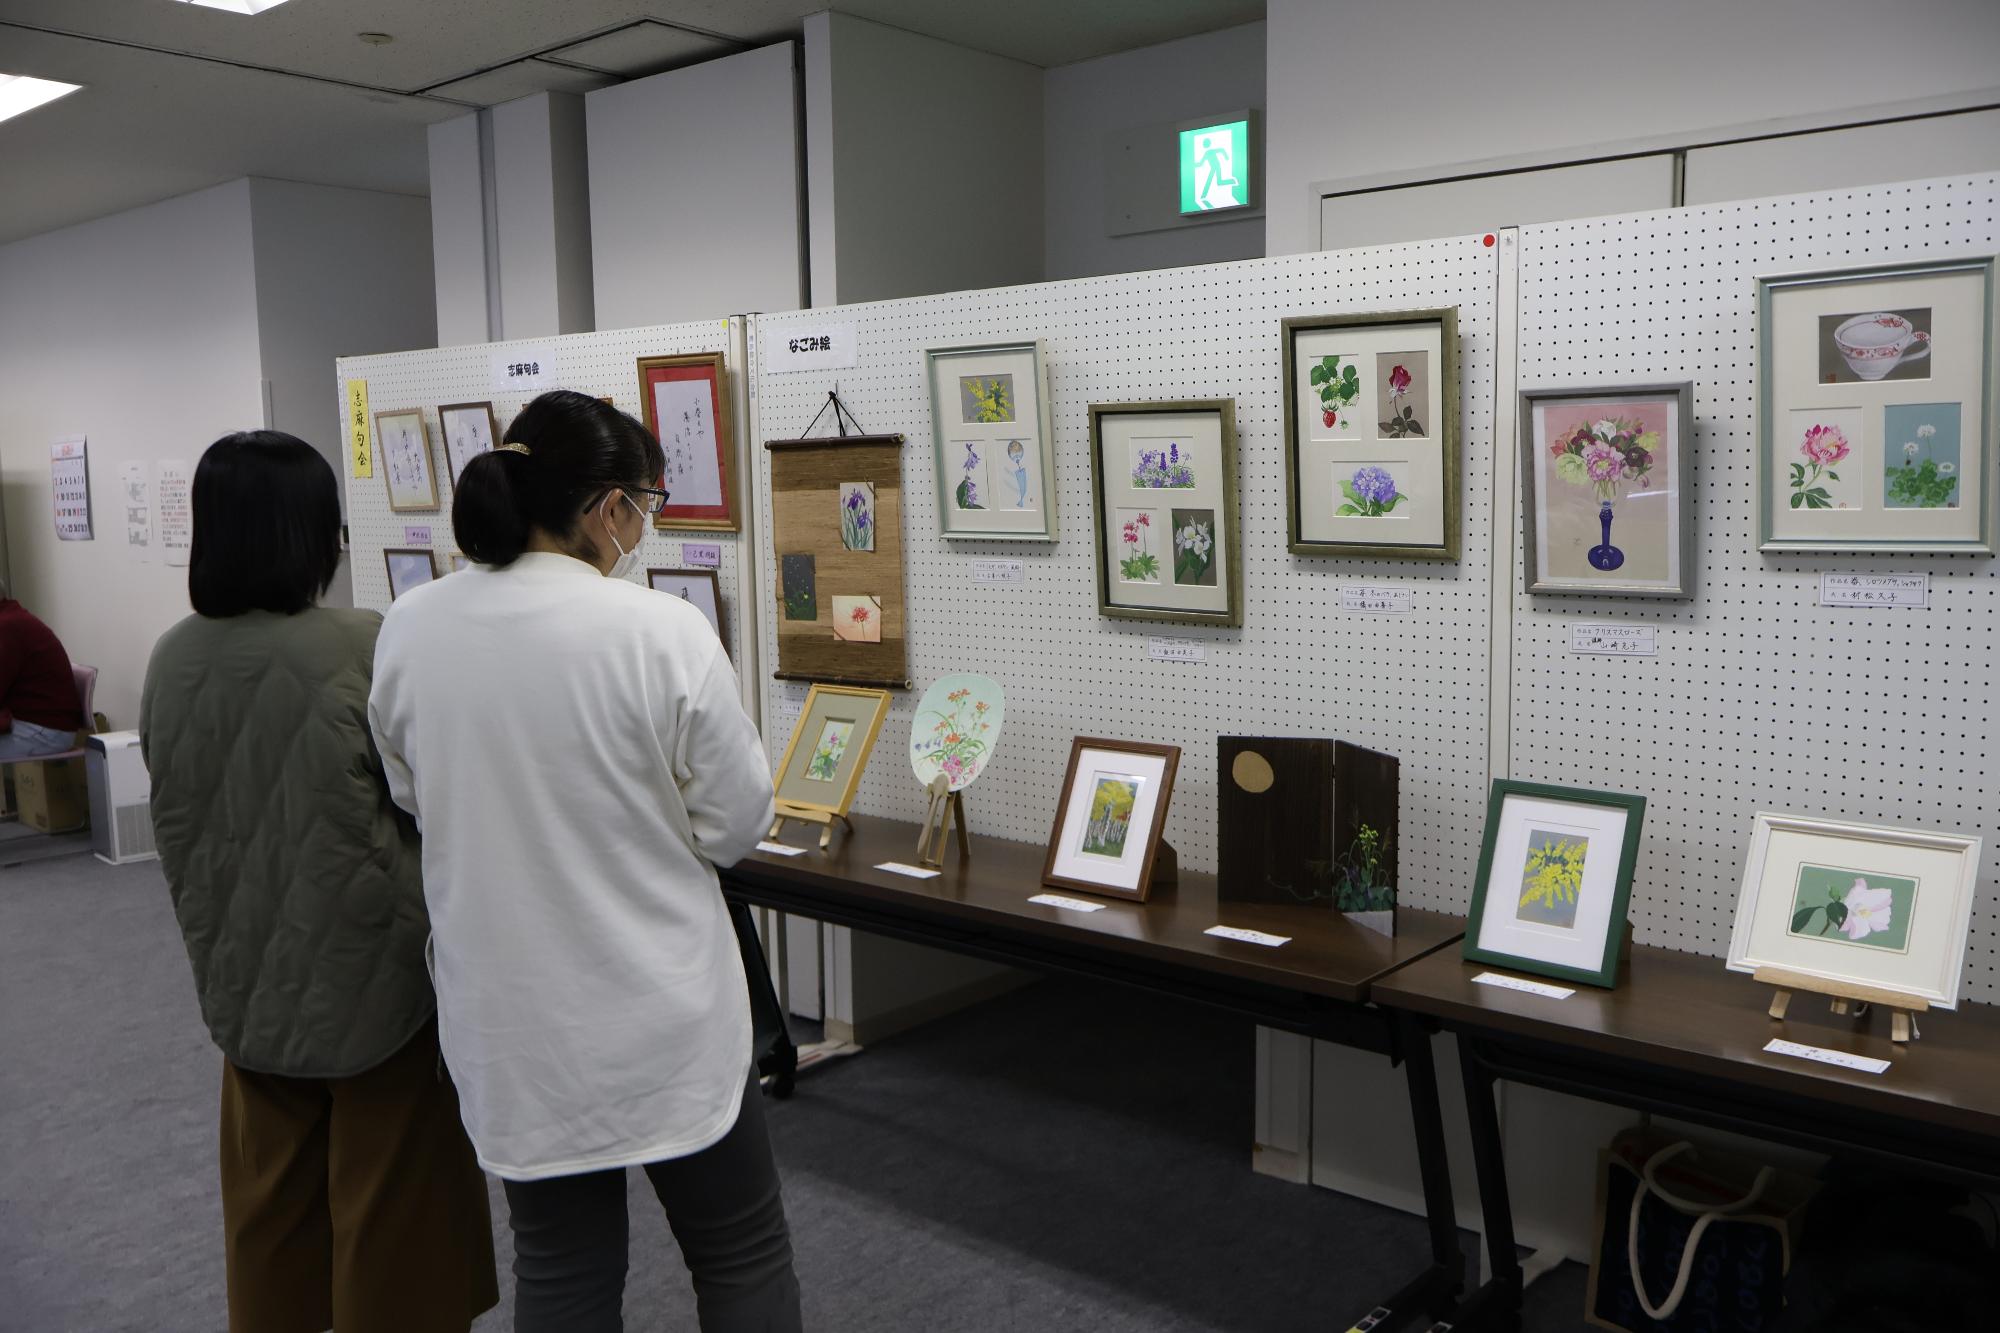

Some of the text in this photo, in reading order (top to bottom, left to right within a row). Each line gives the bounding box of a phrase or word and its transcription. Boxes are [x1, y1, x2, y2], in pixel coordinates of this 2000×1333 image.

[789, 336, 831, 353] なごみ絵
[507, 361, 540, 377] 志麻句会
[354, 390, 367, 466] 志麻句会
[1595, 628, 1643, 637] クリスマスローズ
